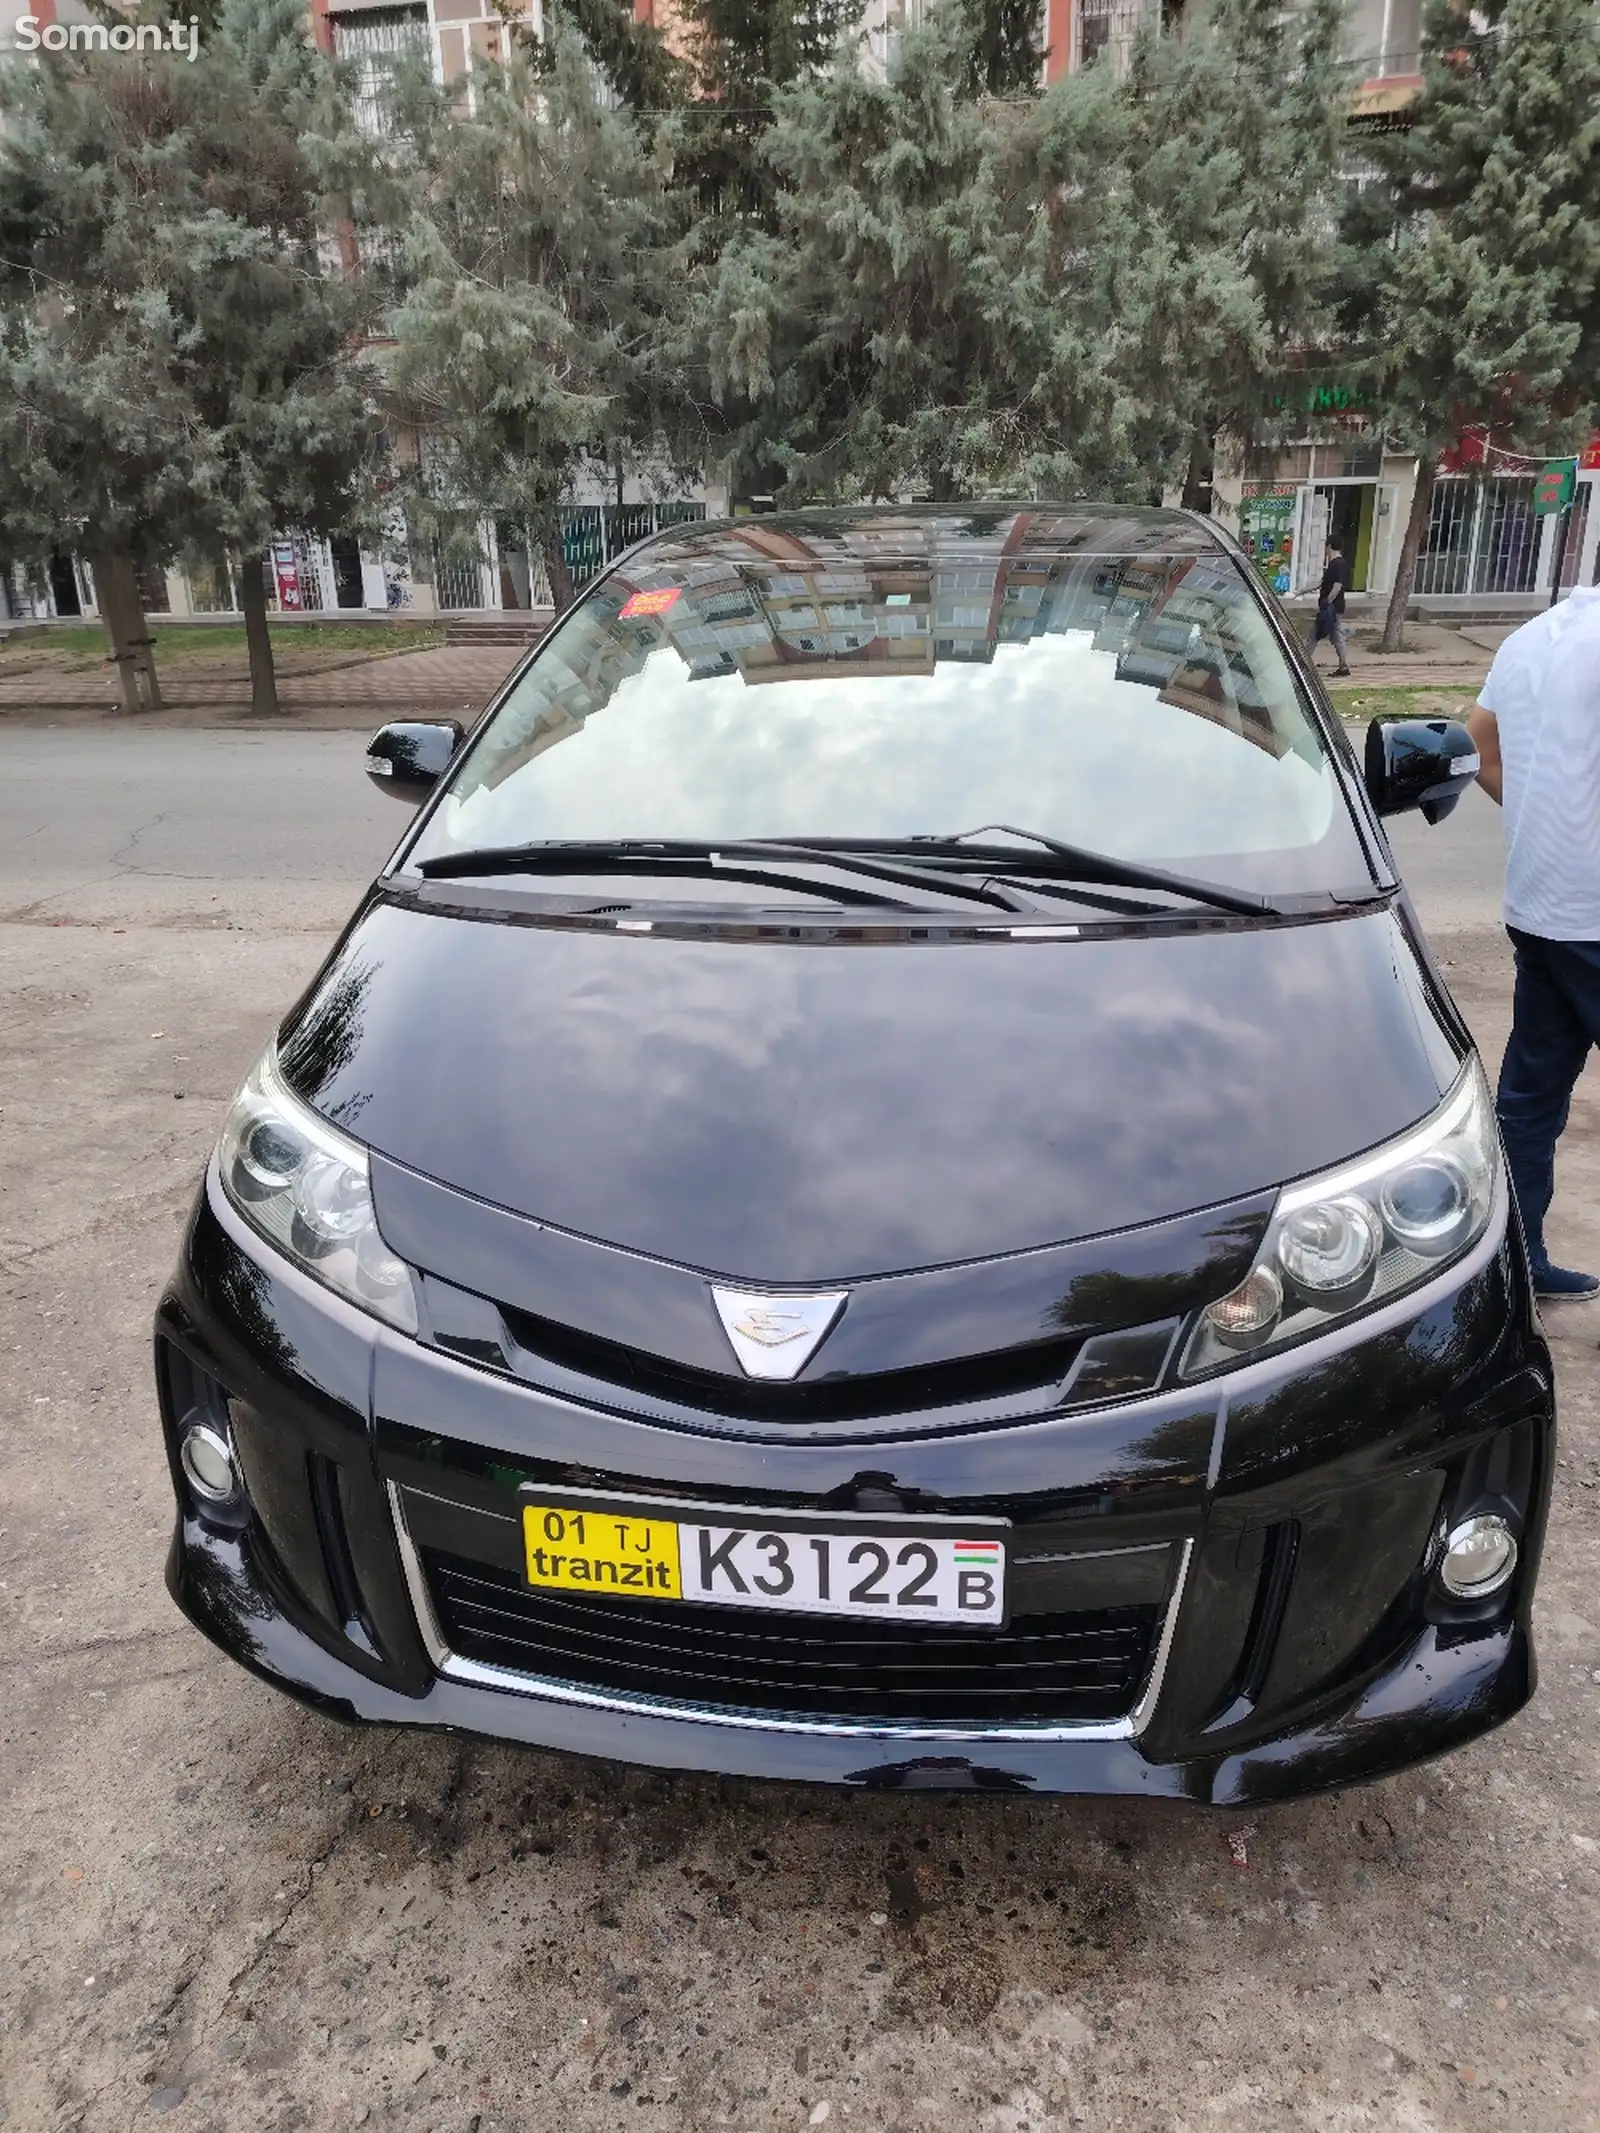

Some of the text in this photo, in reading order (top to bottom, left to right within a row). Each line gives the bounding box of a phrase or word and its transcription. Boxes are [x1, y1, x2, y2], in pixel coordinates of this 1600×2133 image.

[543, 1511, 651, 1553] 01 TJ
[532, 1546, 672, 1590] tranzit
[698, 1528, 940, 1608] K3122
[957, 1571, 996, 1611] B
